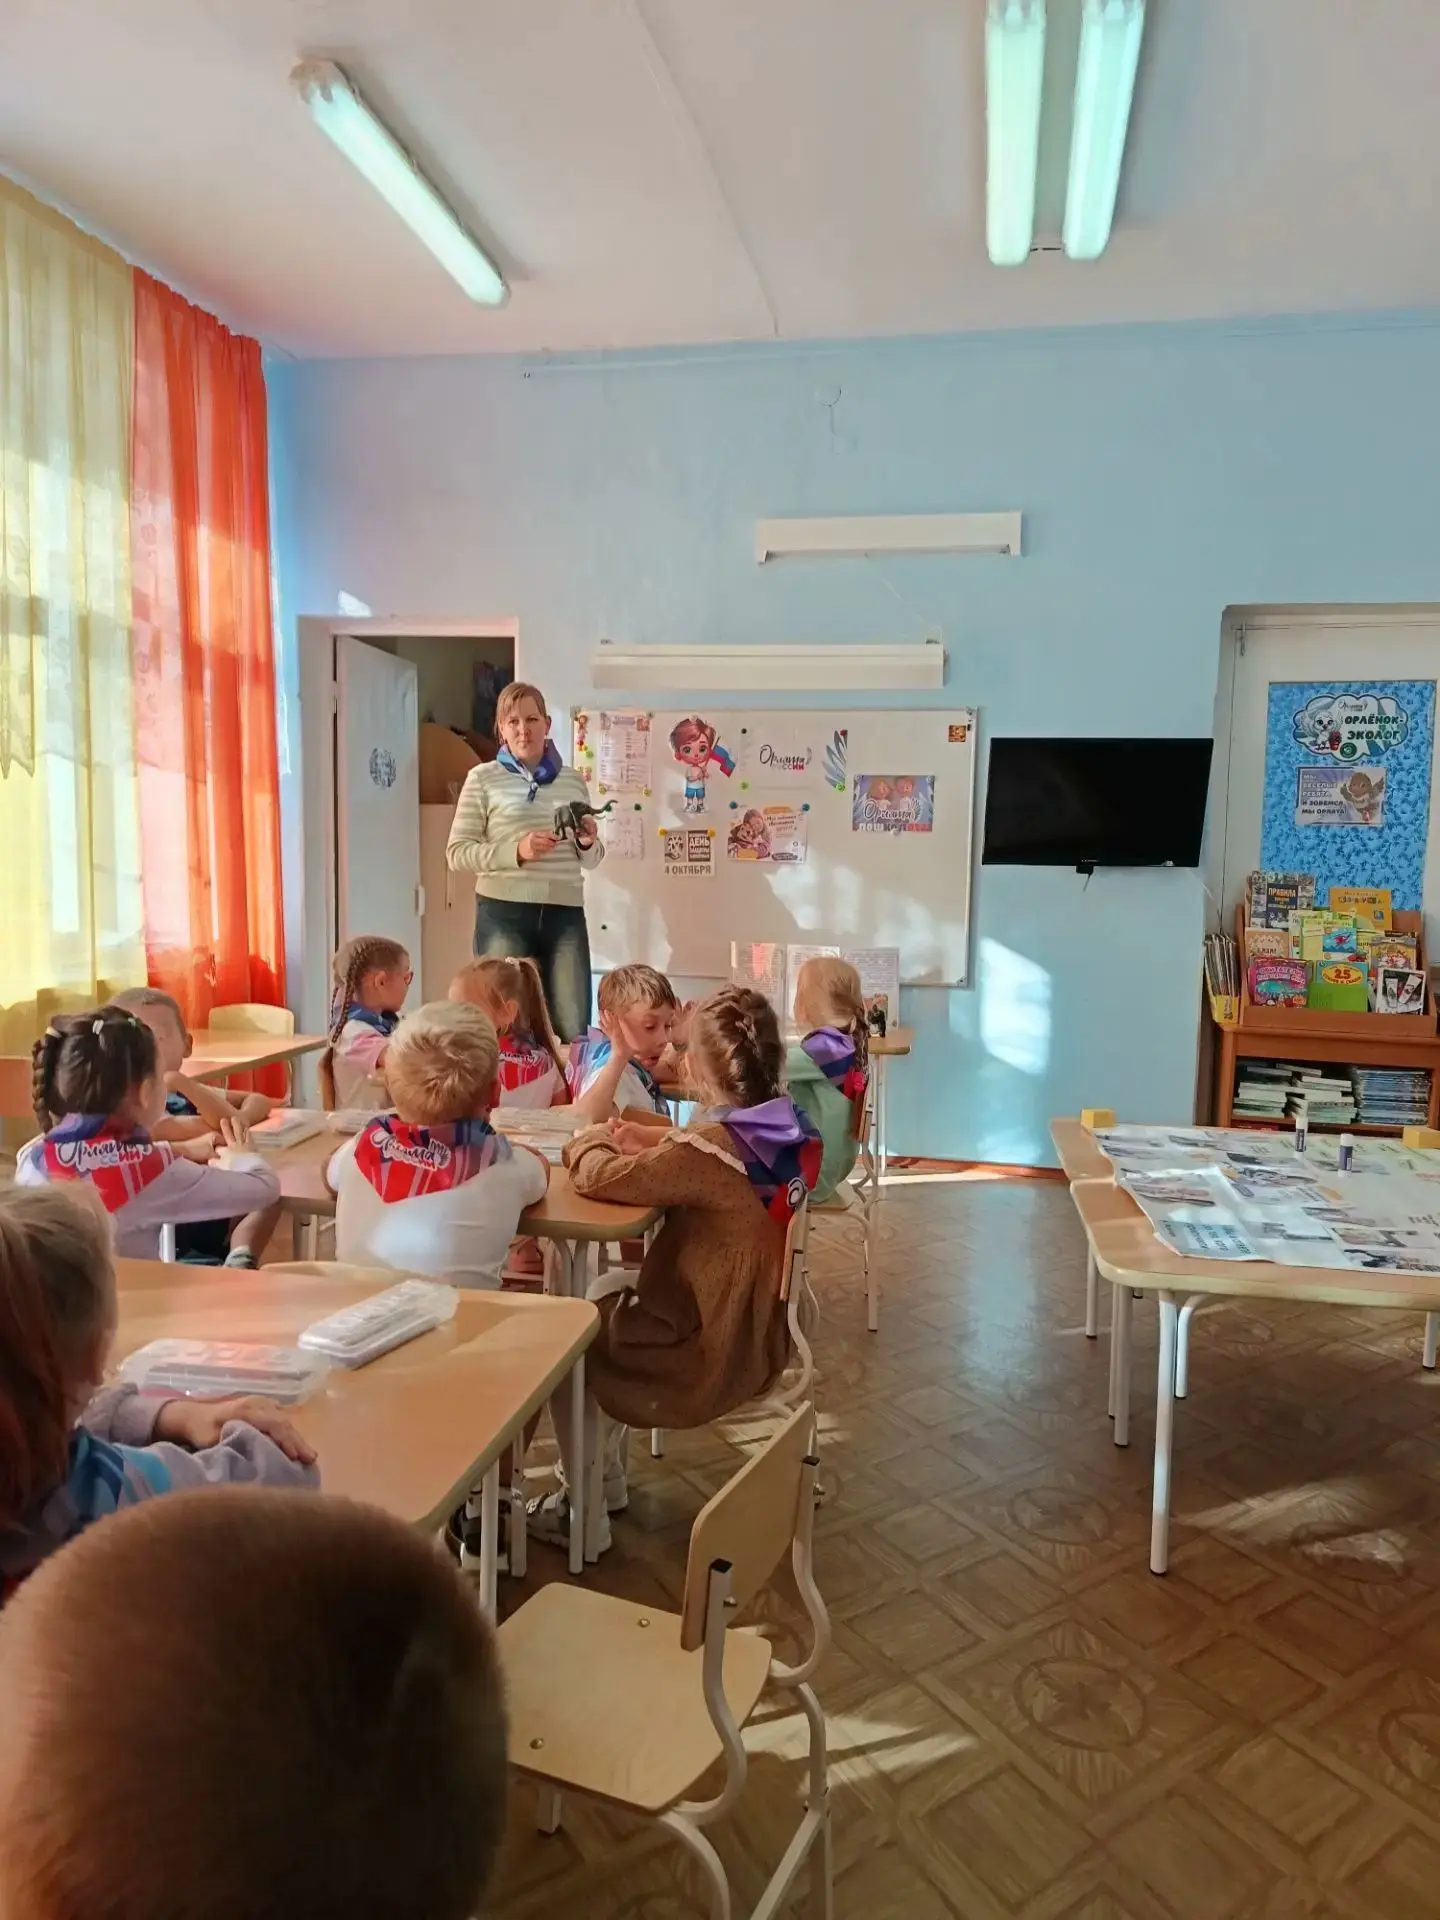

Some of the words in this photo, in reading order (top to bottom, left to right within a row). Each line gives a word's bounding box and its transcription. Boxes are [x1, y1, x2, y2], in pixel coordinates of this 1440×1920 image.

[1344, 714, 1404, 725] ОРЛЁНОК-
[1347, 730, 1400, 741] ЭКОЛОГ
[689, 836, 710, 849] ДЕНЬ
[664, 865, 671, 876] 4
[672, 865, 711, 876] ОКТЯБРЯ
[1268, 887, 1297, 898] ПРАВИЛА
[1334, 968, 1352, 980] 25
